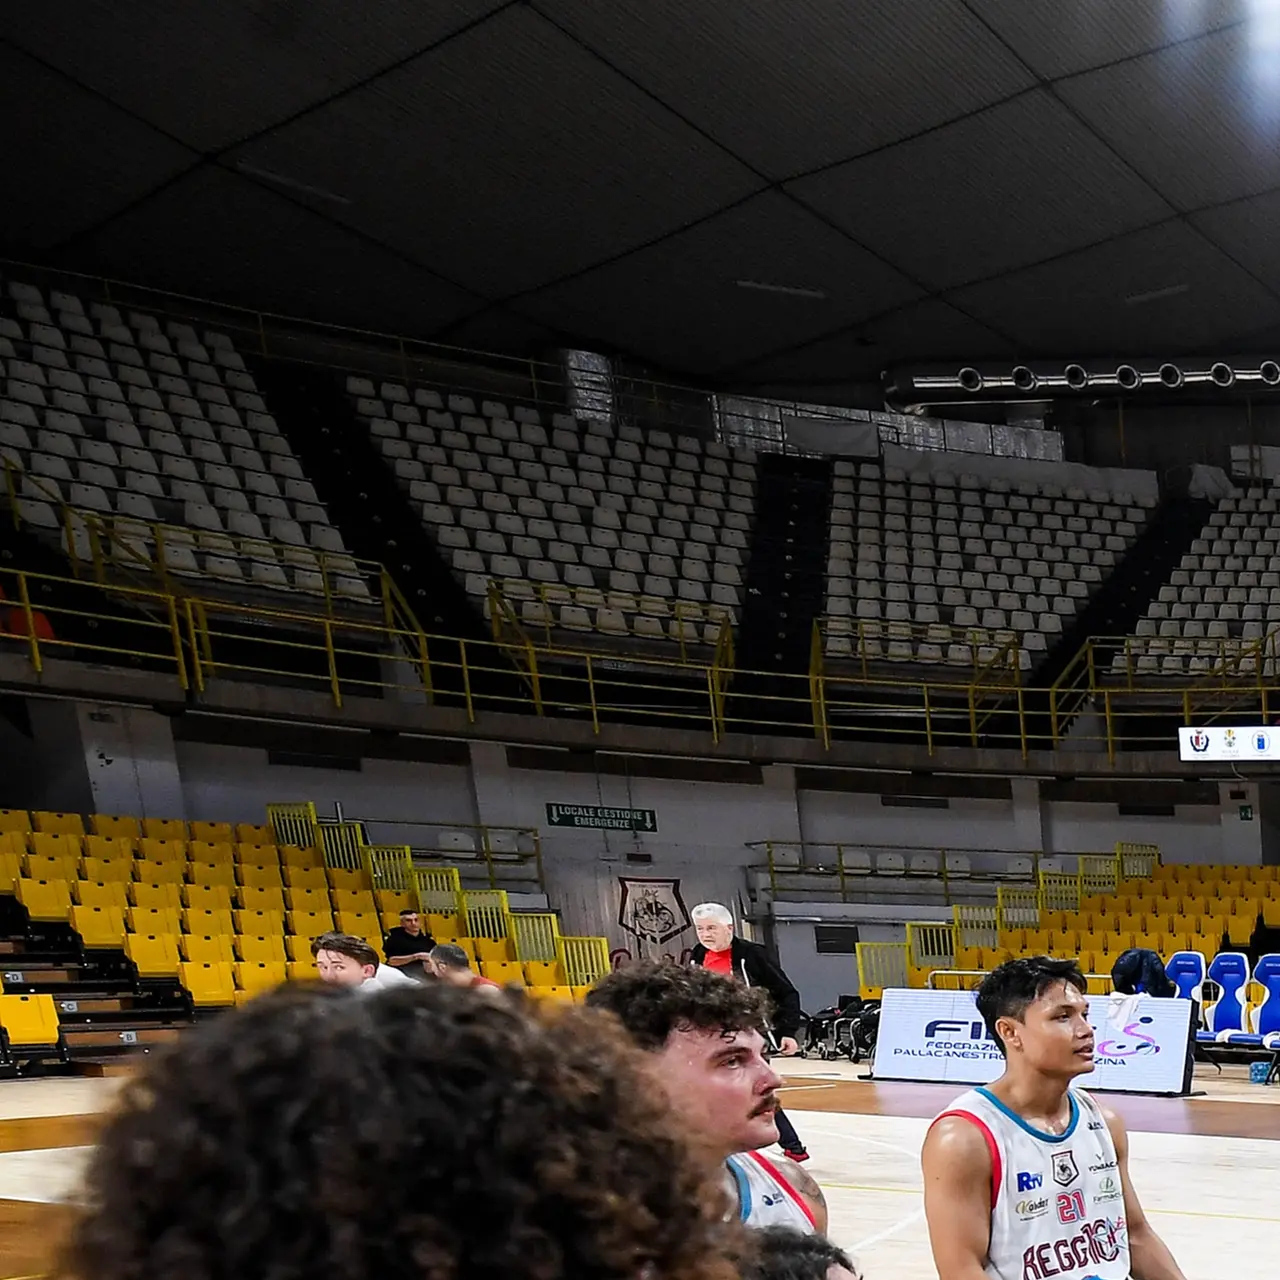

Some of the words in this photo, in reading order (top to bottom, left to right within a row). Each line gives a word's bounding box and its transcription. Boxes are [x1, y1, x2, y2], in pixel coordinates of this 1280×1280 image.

[559, 805, 595, 817] LOCALE
[597, 808, 643, 820] GESTIONE
[574, 817, 630, 829] EMERGENZE
[1017, 1171, 1043, 1192] RTV
[1056, 1188, 1087, 1225] 21
